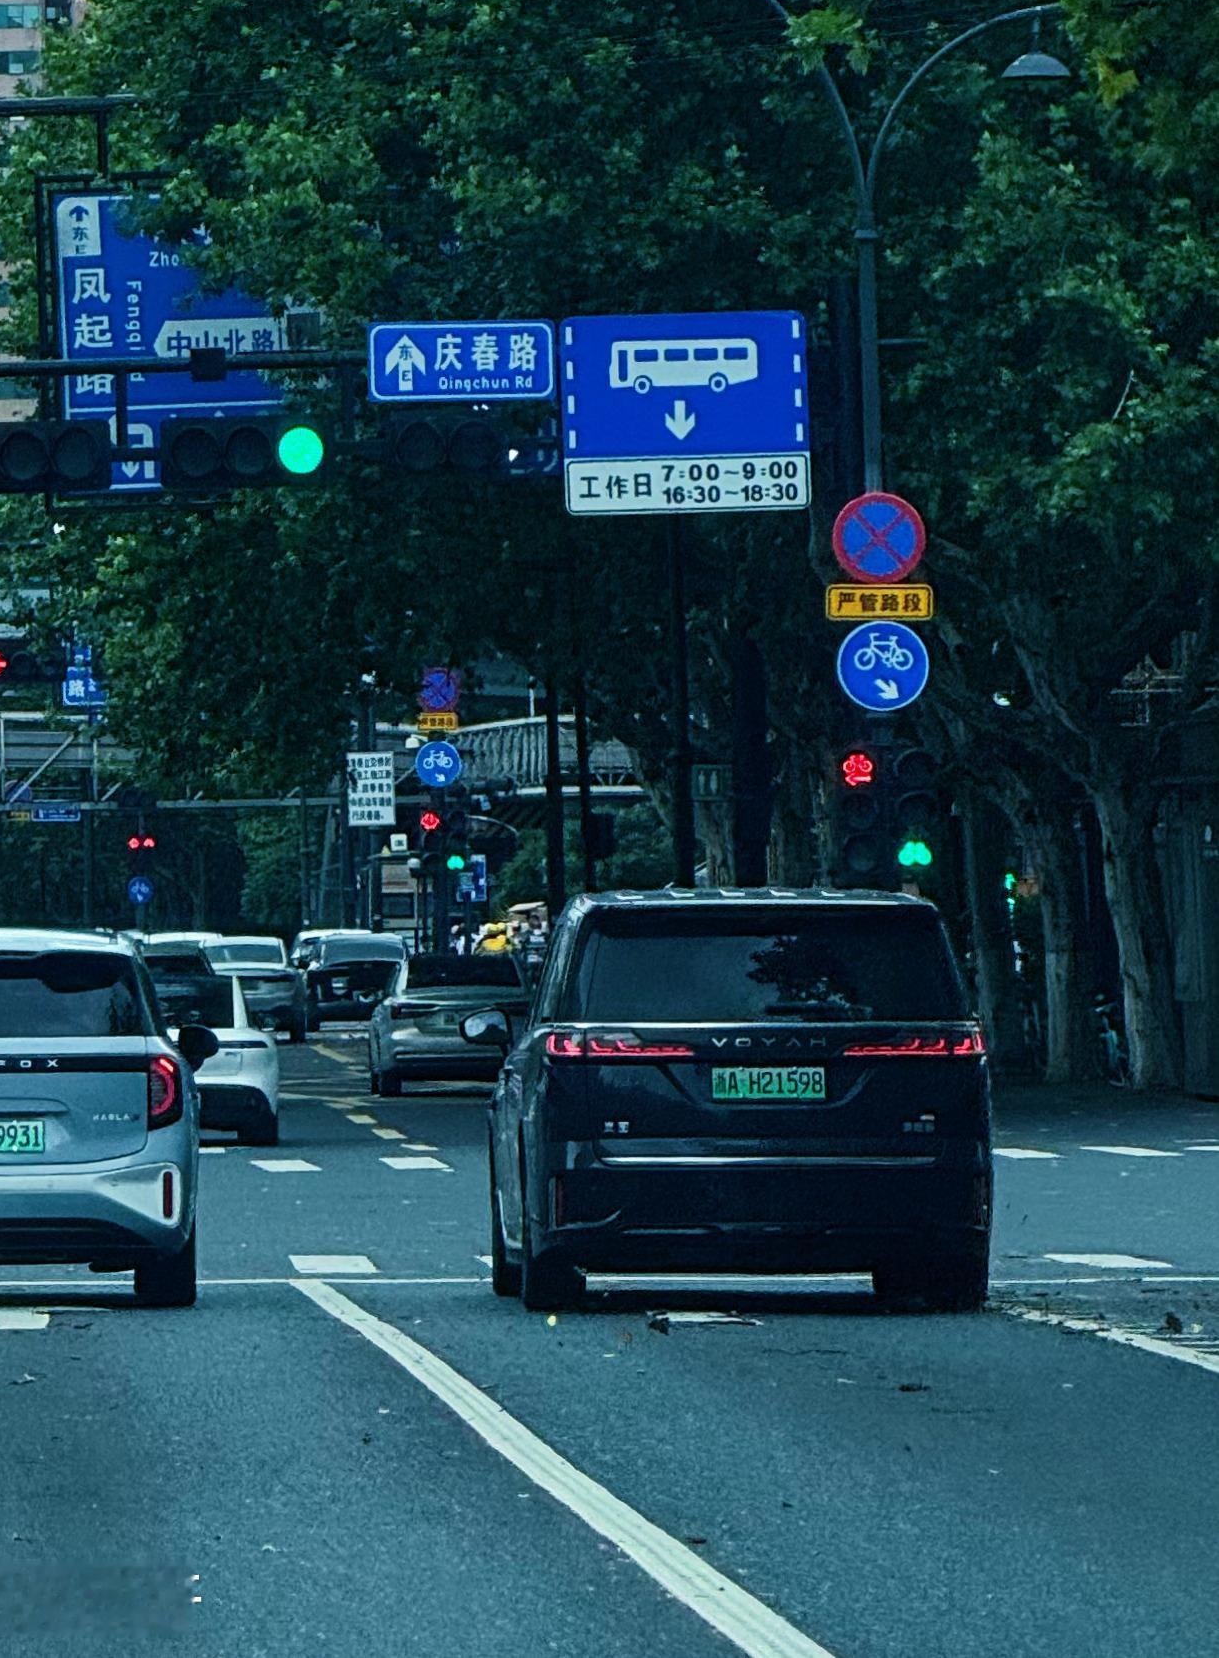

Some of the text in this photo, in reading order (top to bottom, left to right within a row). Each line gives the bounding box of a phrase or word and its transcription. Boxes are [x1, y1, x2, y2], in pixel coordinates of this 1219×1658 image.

[72, 226, 89, 241] 东
[124, 280, 146, 351] Fengqi
[166, 328, 275, 358] 中山北路
[398, 344, 413, 361] 东
[434, 332, 537, 371] 庆春路
[401, 370, 411, 381] E
[438, 375, 532, 392] Qingchun Rd
[579, 473, 652, 500] 工作日
[837, 591, 922, 613] 严管路段
[711, 1037, 827, 1048] VOYAH
